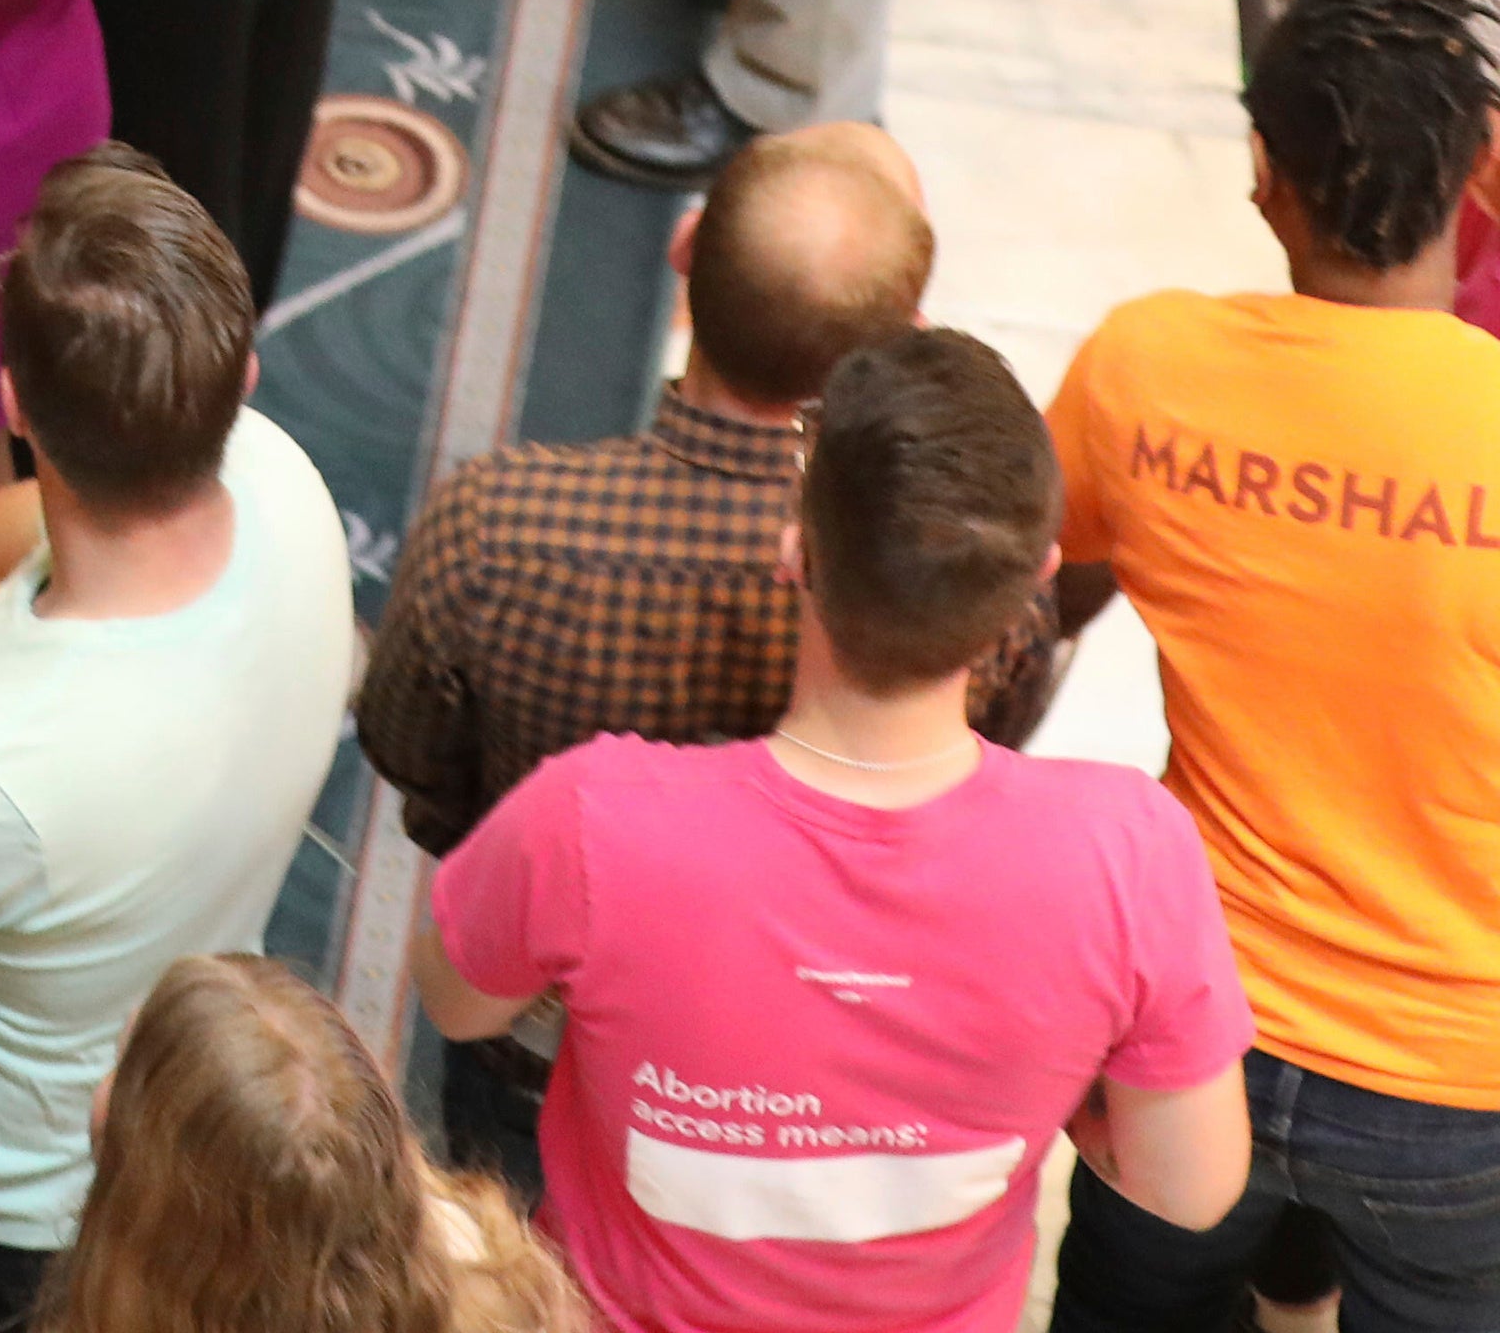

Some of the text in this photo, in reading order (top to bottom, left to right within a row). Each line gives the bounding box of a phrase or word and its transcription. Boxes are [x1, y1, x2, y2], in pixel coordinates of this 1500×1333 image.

[1131, 421, 1500, 550] MARSHAL
[631, 1059, 822, 1117] Abortion
[630, 1097, 930, 1148] access means:
